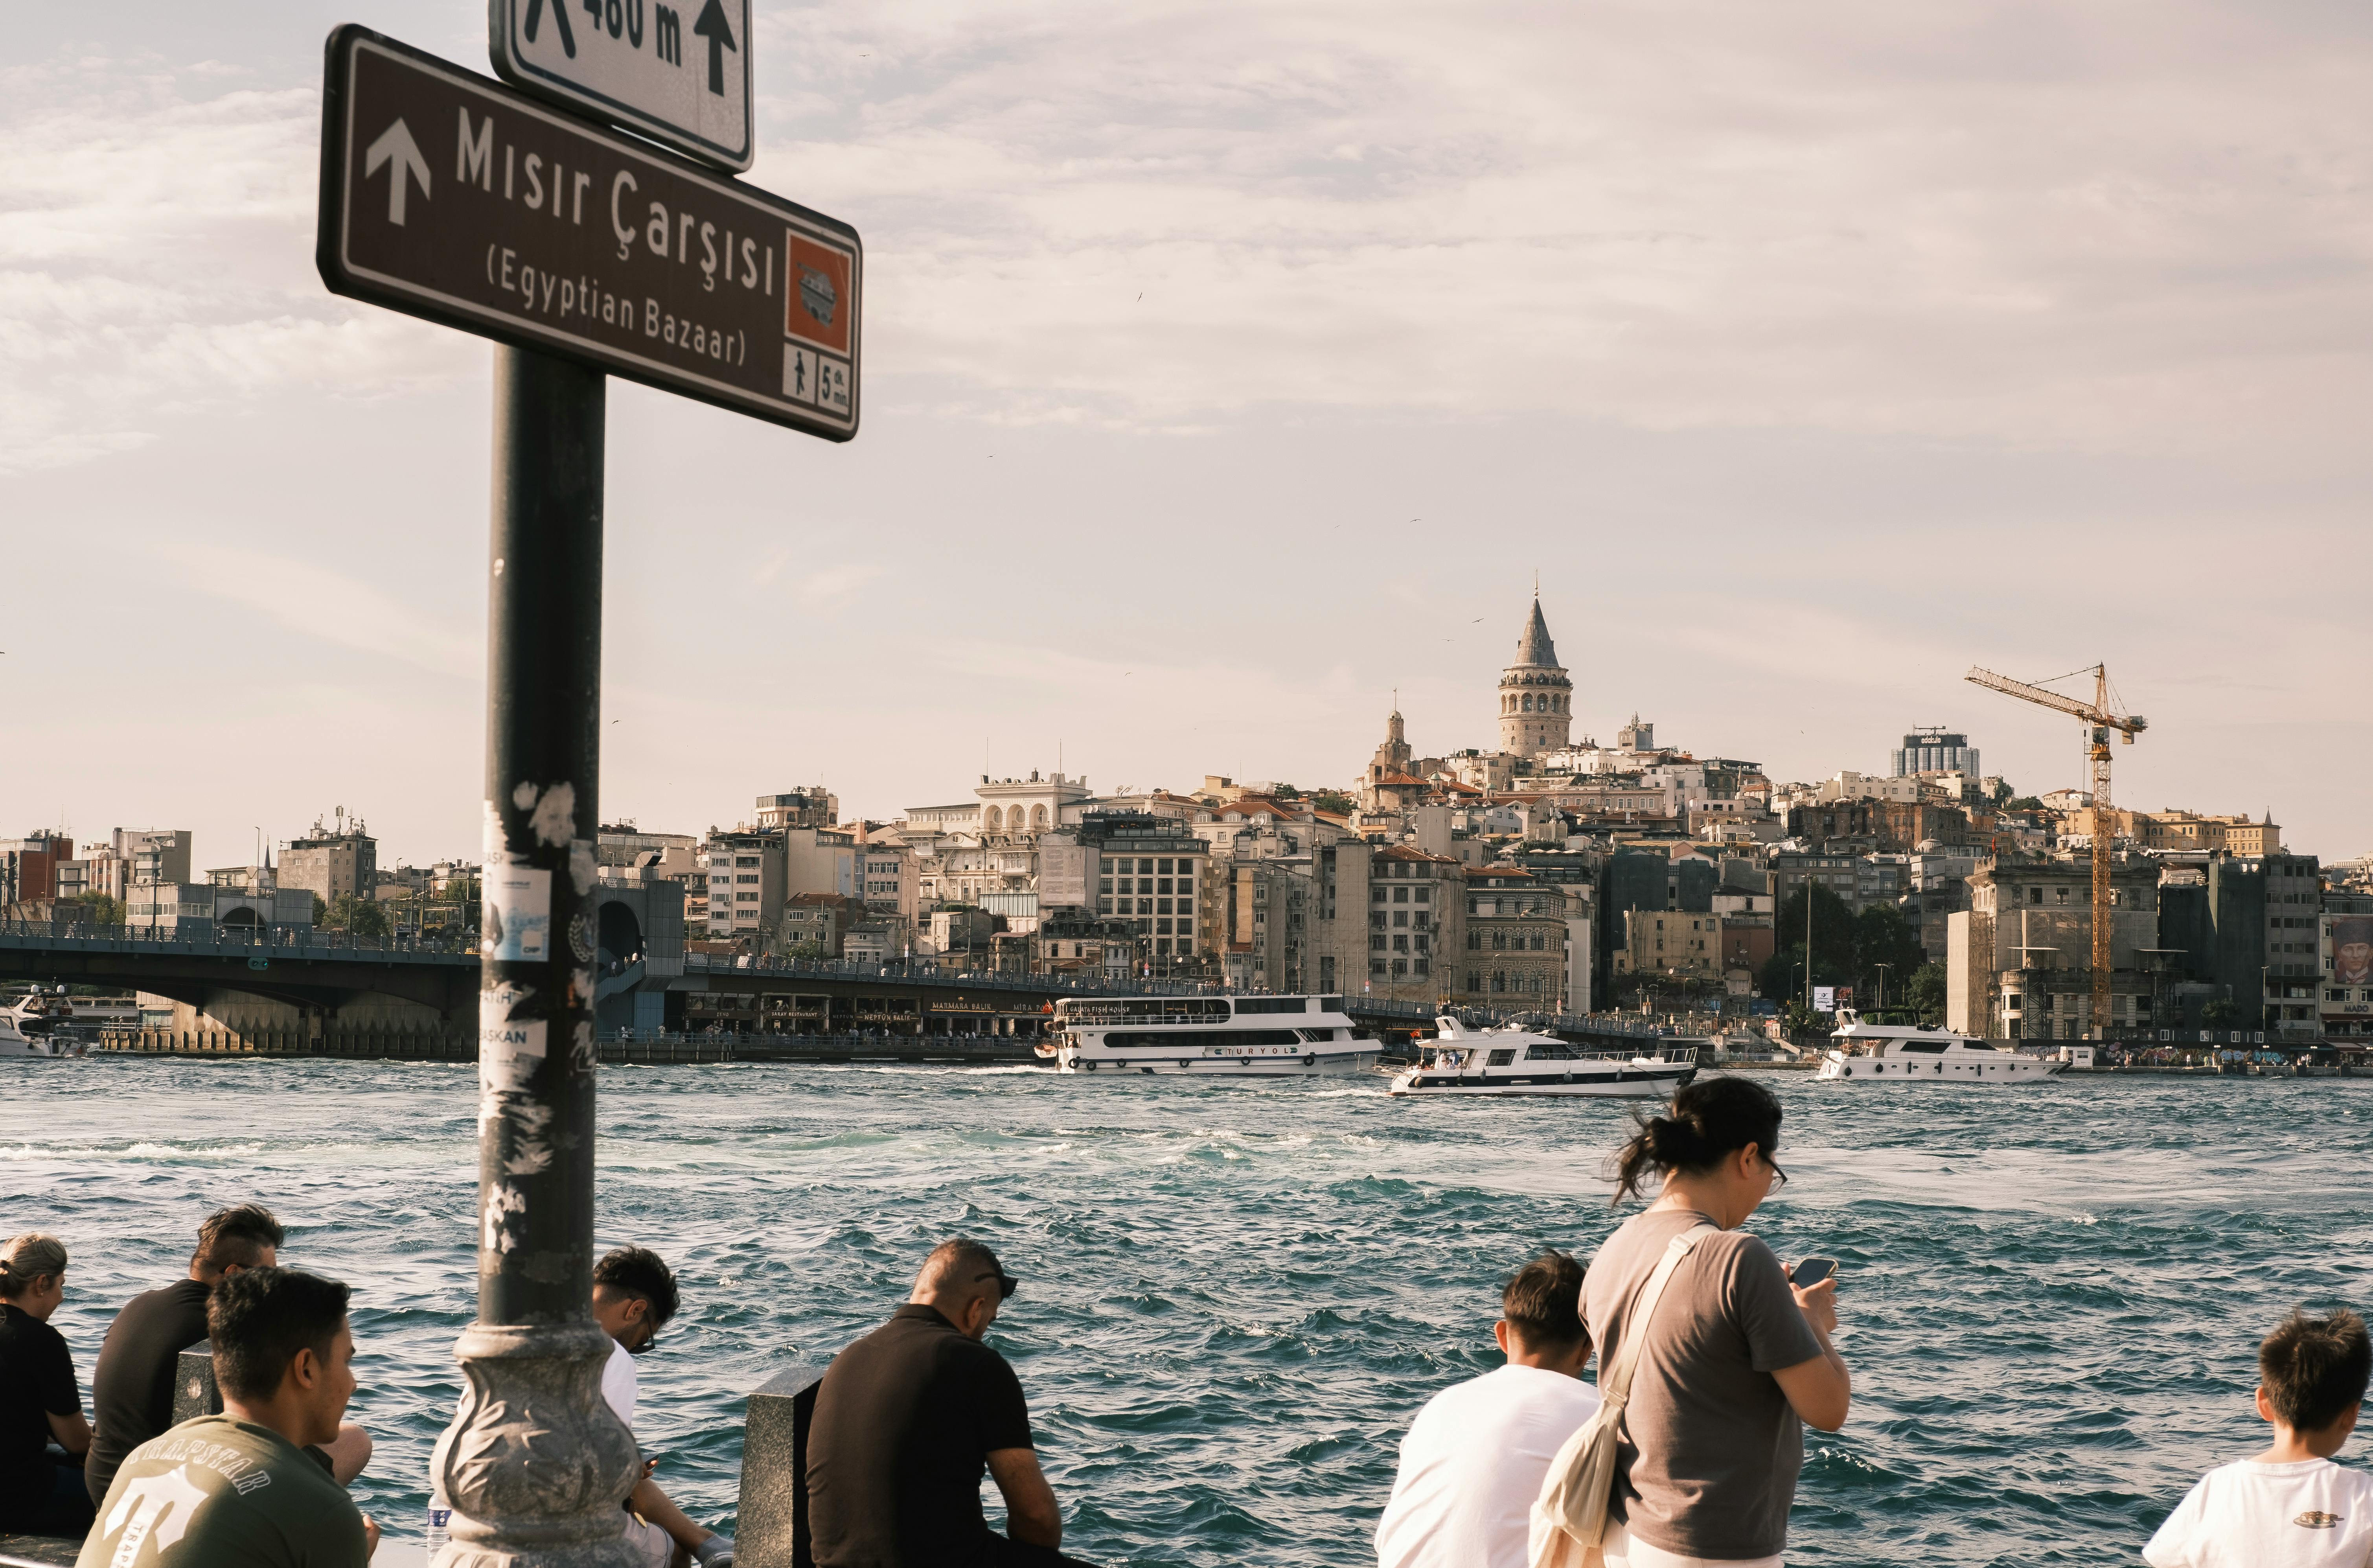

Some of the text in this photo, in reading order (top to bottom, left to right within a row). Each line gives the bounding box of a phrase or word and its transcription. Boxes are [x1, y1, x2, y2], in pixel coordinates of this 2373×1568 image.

[656, 2, 681, 68] m
[456, 107, 774, 296] Mısır Çarşısı
[486, 243, 746, 366] (Egyptian Bazaar)
[822, 364, 830, 400] 5
[129, 1439, 271, 1496] TRAPSTAR
[118, 1526, 143, 1568] TRAP
